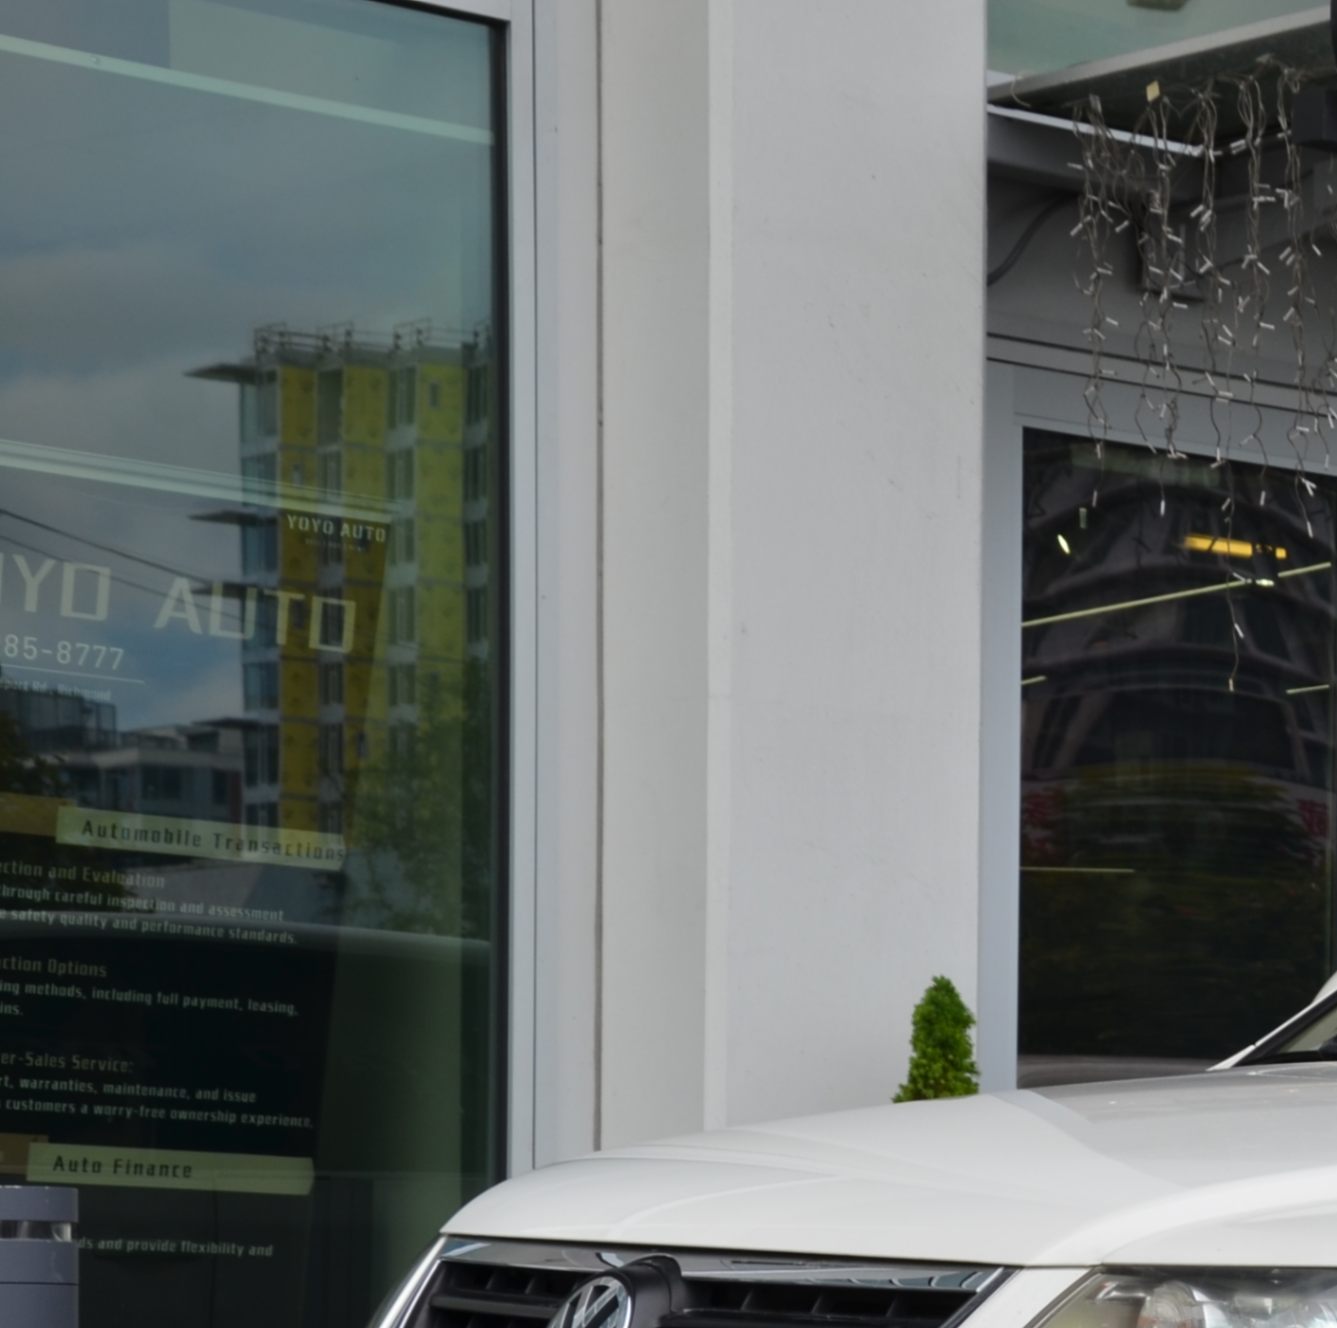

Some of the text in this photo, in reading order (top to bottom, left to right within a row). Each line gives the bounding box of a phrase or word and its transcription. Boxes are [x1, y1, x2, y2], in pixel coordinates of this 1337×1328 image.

[287, 513, 387, 543] YOYO AUTO
[0, 551, 357, 655] YO AUTO
[81, 819, 346, 862] Automobile Transactions
[48, 863, 77, 881] and
[82, 867, 166, 889] Evaluation
[54, 889, 104, 906] careful
[179, 898, 204, 914] and
[208, 904, 285, 922] assessment
[11, 908, 55, 925] safety
[60, 912, 108, 930] quality
[112, 915, 138, 931] and
[141, 919, 225, 939] performance
[48, 958, 108, 978] Options
[92, 986, 153, 1005] including
[157, 991, 180, 1006] full
[195, 1088, 220, 1102] and
[223, 1089, 257, 1104] issue
[6, 1098, 76, 1115] customers
[80, 1104, 89, 1115] a
[170, 1108, 237, 1126] ownership
[52, 1155, 193, 1180] Auto Finance
[98, 1238, 122, 1251] and
[126, 1239, 177, 1254] provide
[180, 1240, 245, 1258] flexibility
[248, 1243, 275, 1257] and
